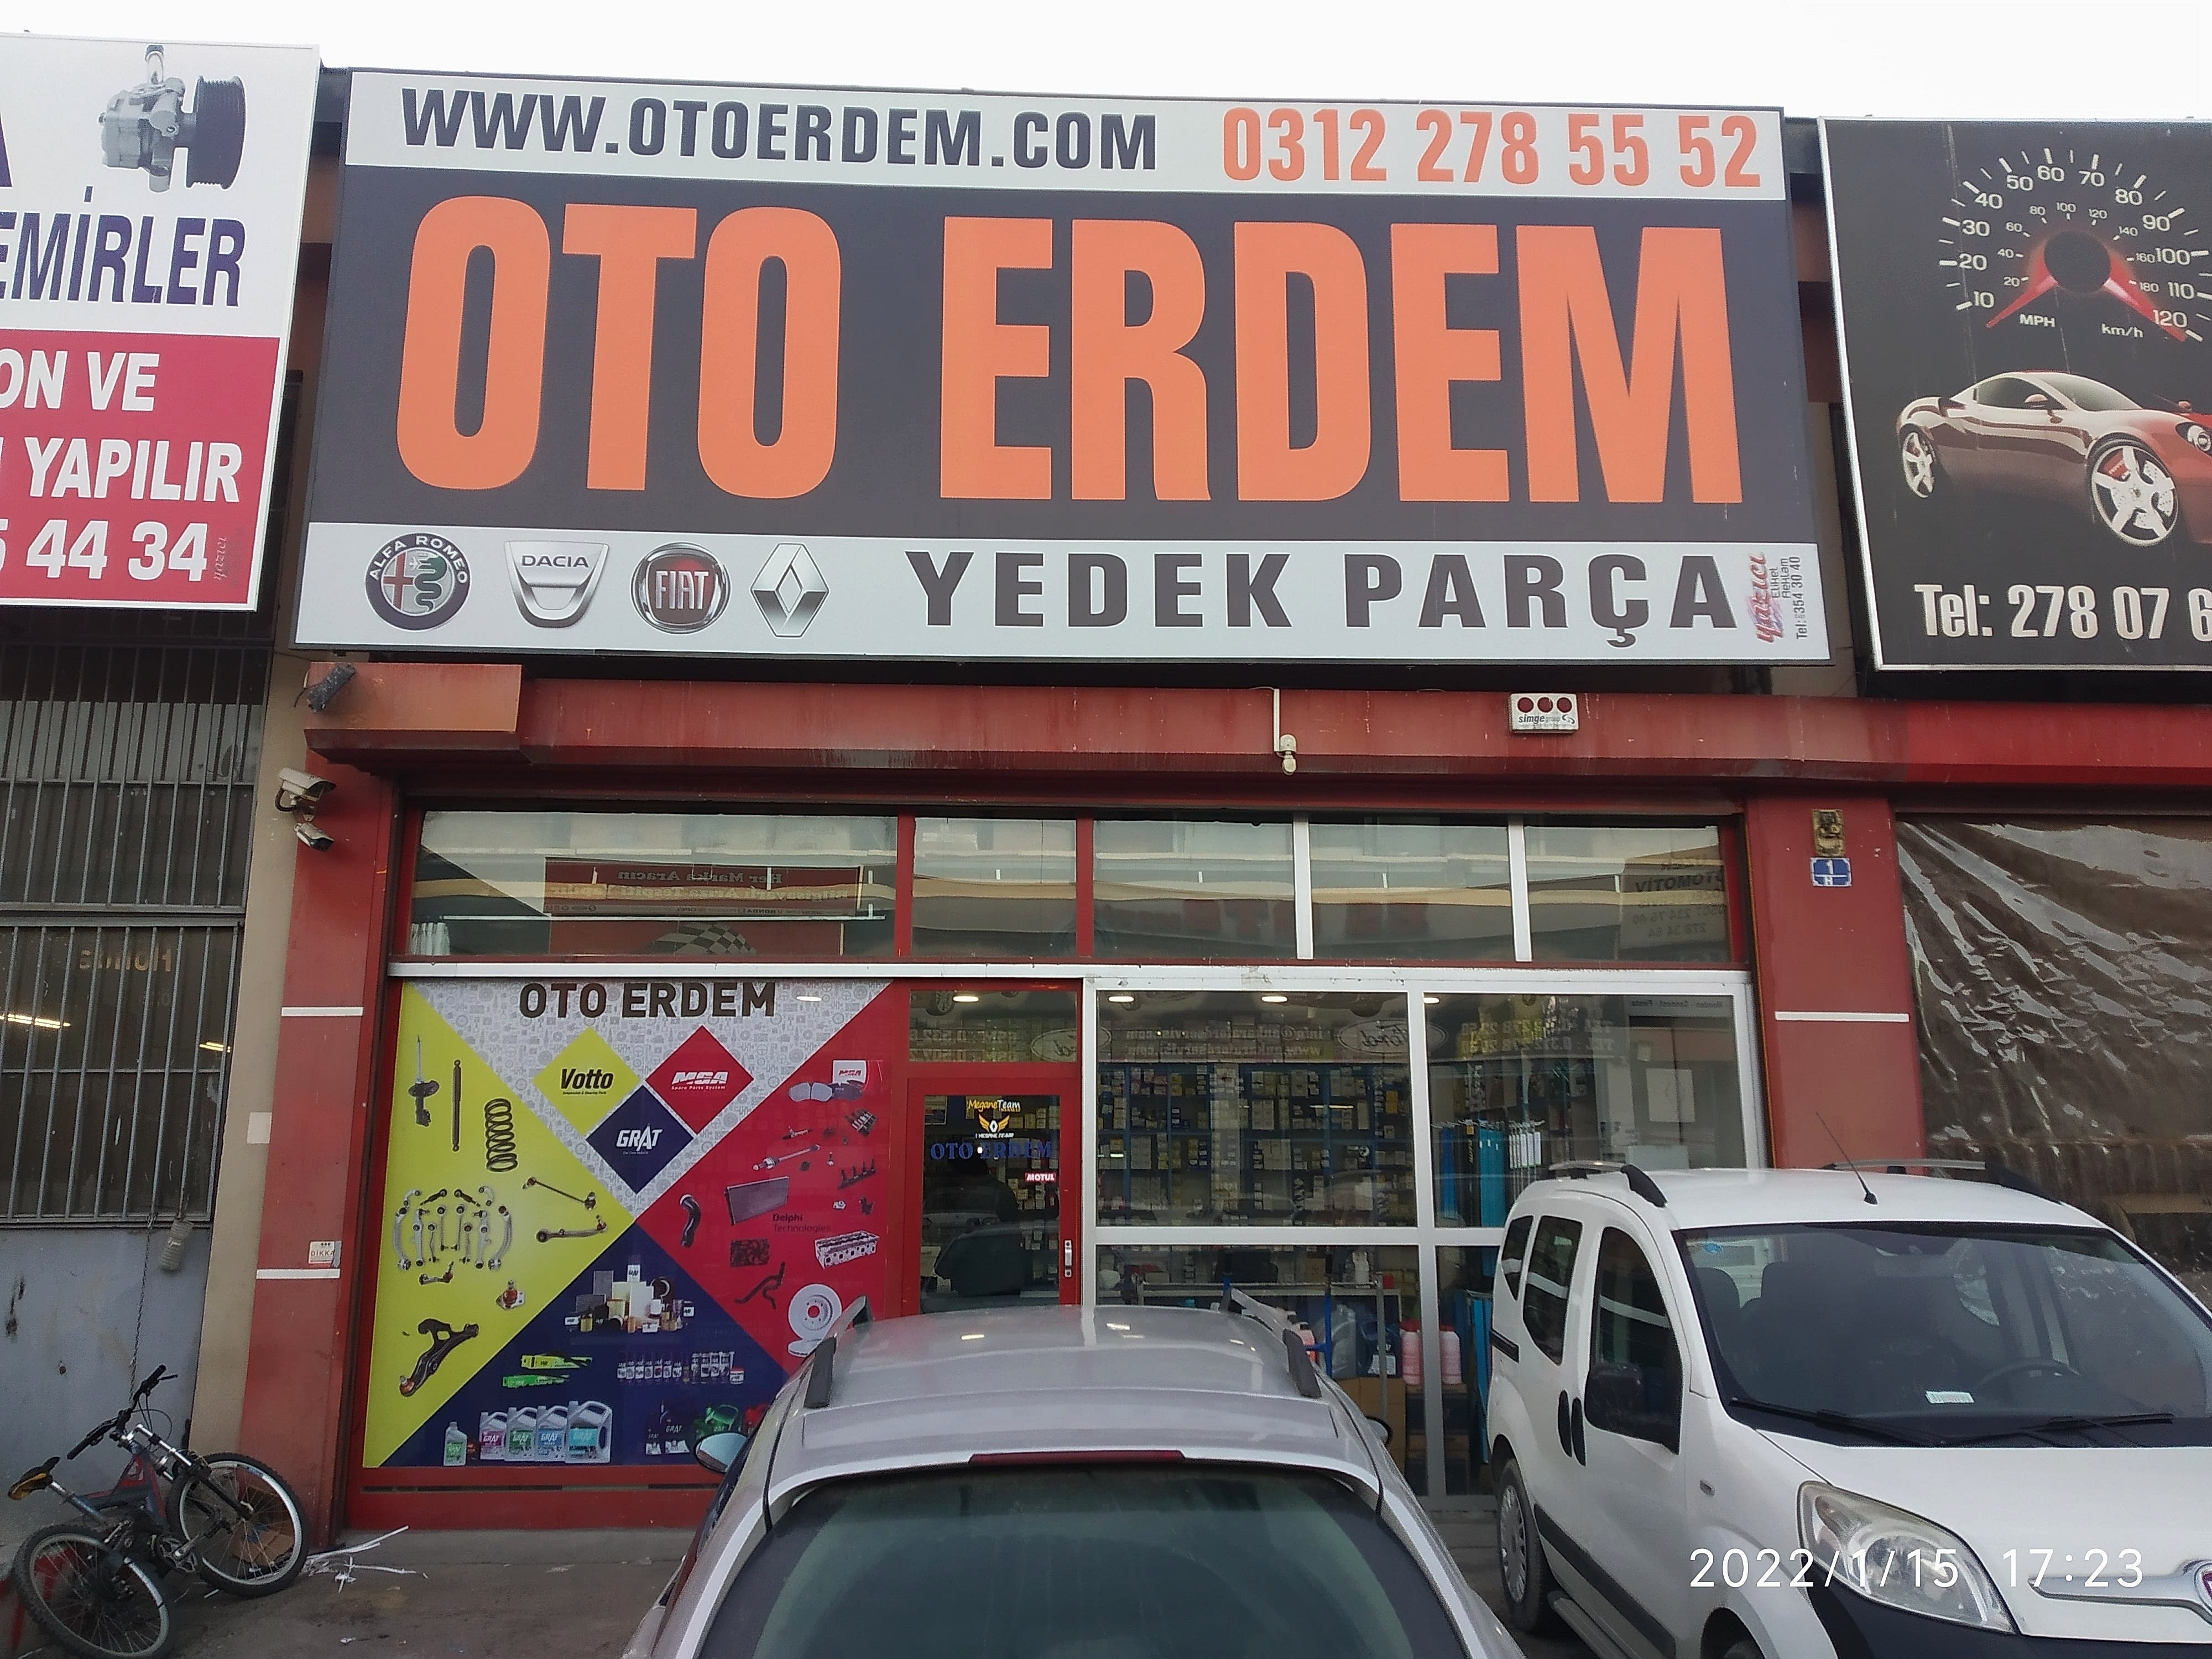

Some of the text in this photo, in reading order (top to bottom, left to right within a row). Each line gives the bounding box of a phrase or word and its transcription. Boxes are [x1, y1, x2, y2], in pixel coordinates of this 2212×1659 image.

[401, 87, 1156, 170] WWW.OTOERDEM.COM
[1222, 107, 1761, 188] 0312 278 55 52
[2037, 166, 2064, 182] 60
[2078, 171, 2105, 187] 70
[2006, 175, 2033, 191] 50
[1975, 192, 2004, 209] 40
[2115, 189, 2143, 206] 80
[2030, 205, 2046, 216] 80
[2056, 202, 2076, 213] 100
[2088, 208, 2107, 219] 120
[1963, 220, 1990, 236] 30
[2006, 222, 2022, 232] 60
[2143, 214, 2171, 231] 90
[2119, 226, 2138, 237] 140
[1997, 248, 2014, 258] 40
[2135, 252, 2155, 263] 160
[2155, 247, 2190, 265] 100
[1959, 254, 1987, 271] 20
[2004, 276, 2020, 287] 20
[2139, 282, 2159, 293] 180
[2167, 282, 2194, 299] 110
[1973, 291, 1994, 308] 10
[2020, 314, 2055, 327] MPH
[2153, 310, 2188, 328] 120
[2101, 324, 2143, 338] km/h
[396, 195, 1743, 504] OTO ERDEM
[87, 352, 160, 411] VE
[24, 437, 242, 503] YAPILIR
[26, 519, 109, 580] 44
[128, 521, 208, 582] 34
[369, 535, 468, 584] ALFA ROMEO
[521, 555, 589, 568] DACIA
[1789, 556, 1801, 571] 40
[1791, 574, 1803, 588] 30
[655, 570, 709, 610] FIAT
[905, 550, 1738, 648] YEDEK PARÇA
[1792, 593, 1805, 613] 354
[1913, 583, 1994, 637] Tel:
[2008, 585, 2099, 639] 278
[2112, 586, 2169, 640] 07
[1518, 714, 1545, 724] simge
[1826, 859, 1834, 874] 1
[519, 982, 776, 1019] OTO ERDEM
[561, 1068, 614, 1089] Votto
[671, 1071, 728, 1085] MGA
[615, 1122, 664, 1151] GRAT
[930, 1140, 1052, 1160] OTO ERDEM
[1026, 1173, 1055, 1181] MOTUL
[773, 1213, 803, 1223] Delphi
